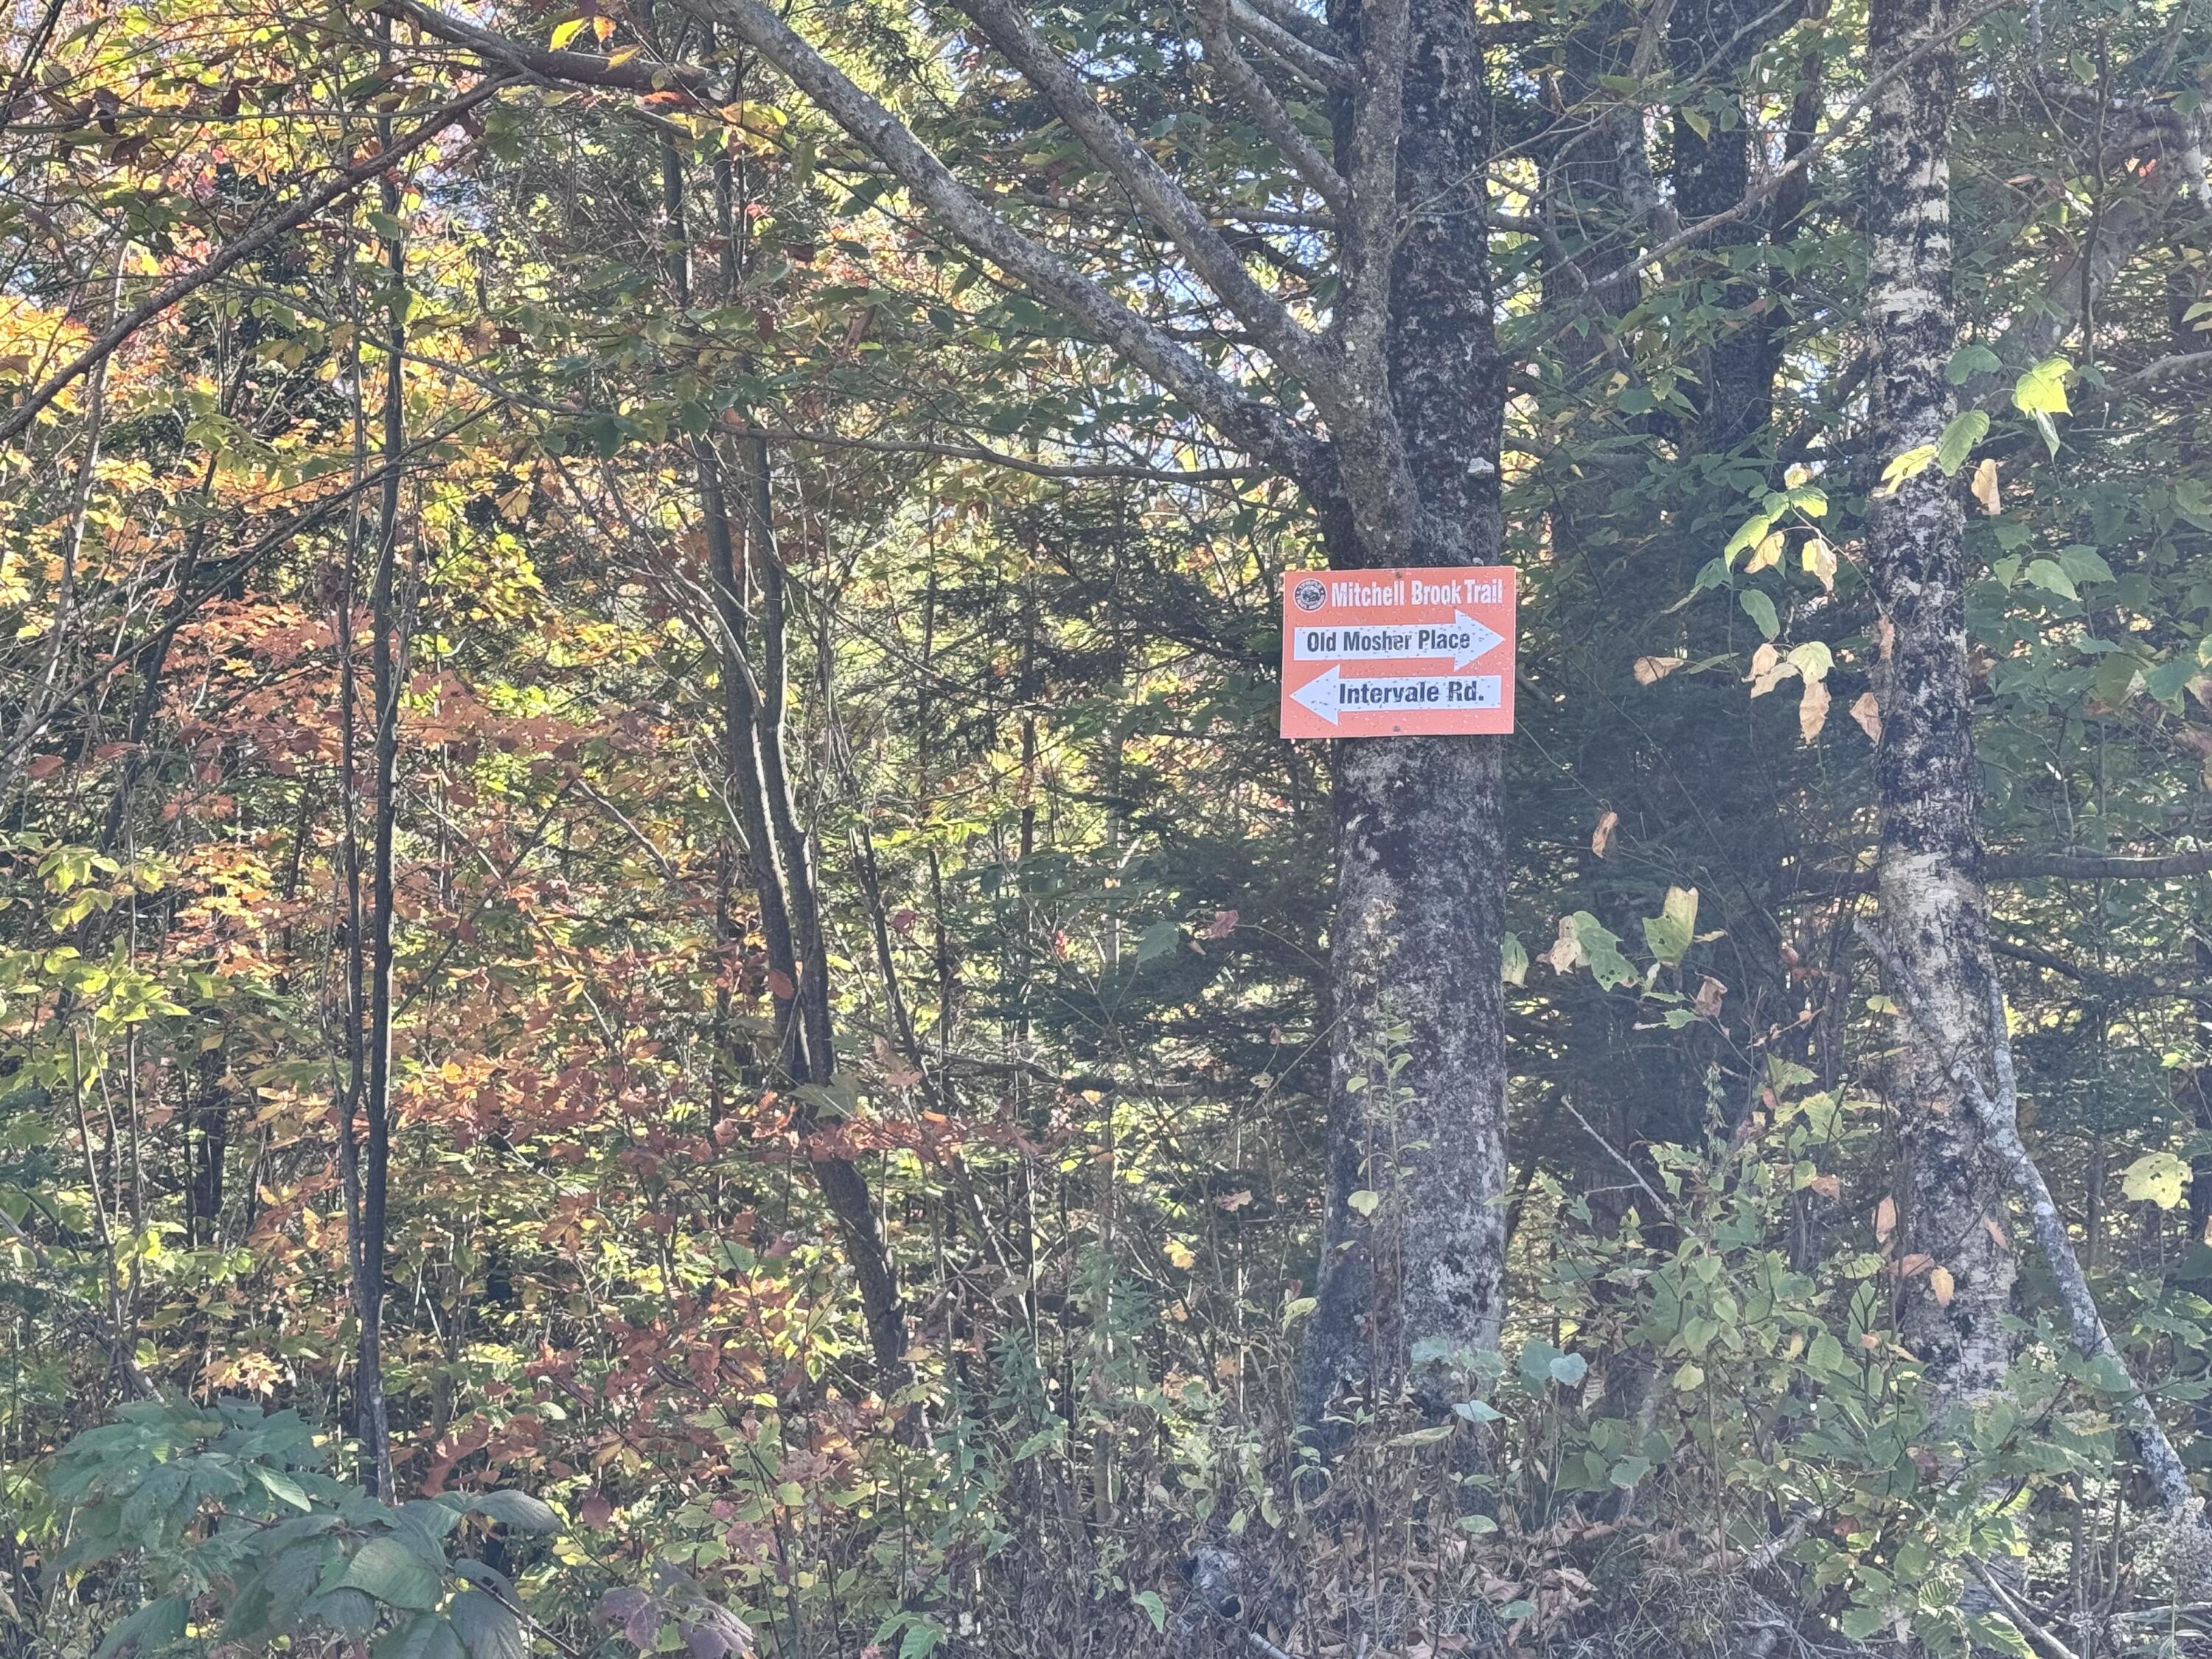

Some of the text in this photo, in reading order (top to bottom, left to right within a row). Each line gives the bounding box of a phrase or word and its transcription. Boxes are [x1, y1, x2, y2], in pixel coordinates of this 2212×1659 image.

[1331, 581, 1405, 607] Mitchell
[1411, 580, 1461, 605] Brook
[1464, 578, 1503, 604] Trail
[1307, 630, 1470, 652] Old Mosher Place
[1339, 681, 1484, 704] Intervale Rd.
